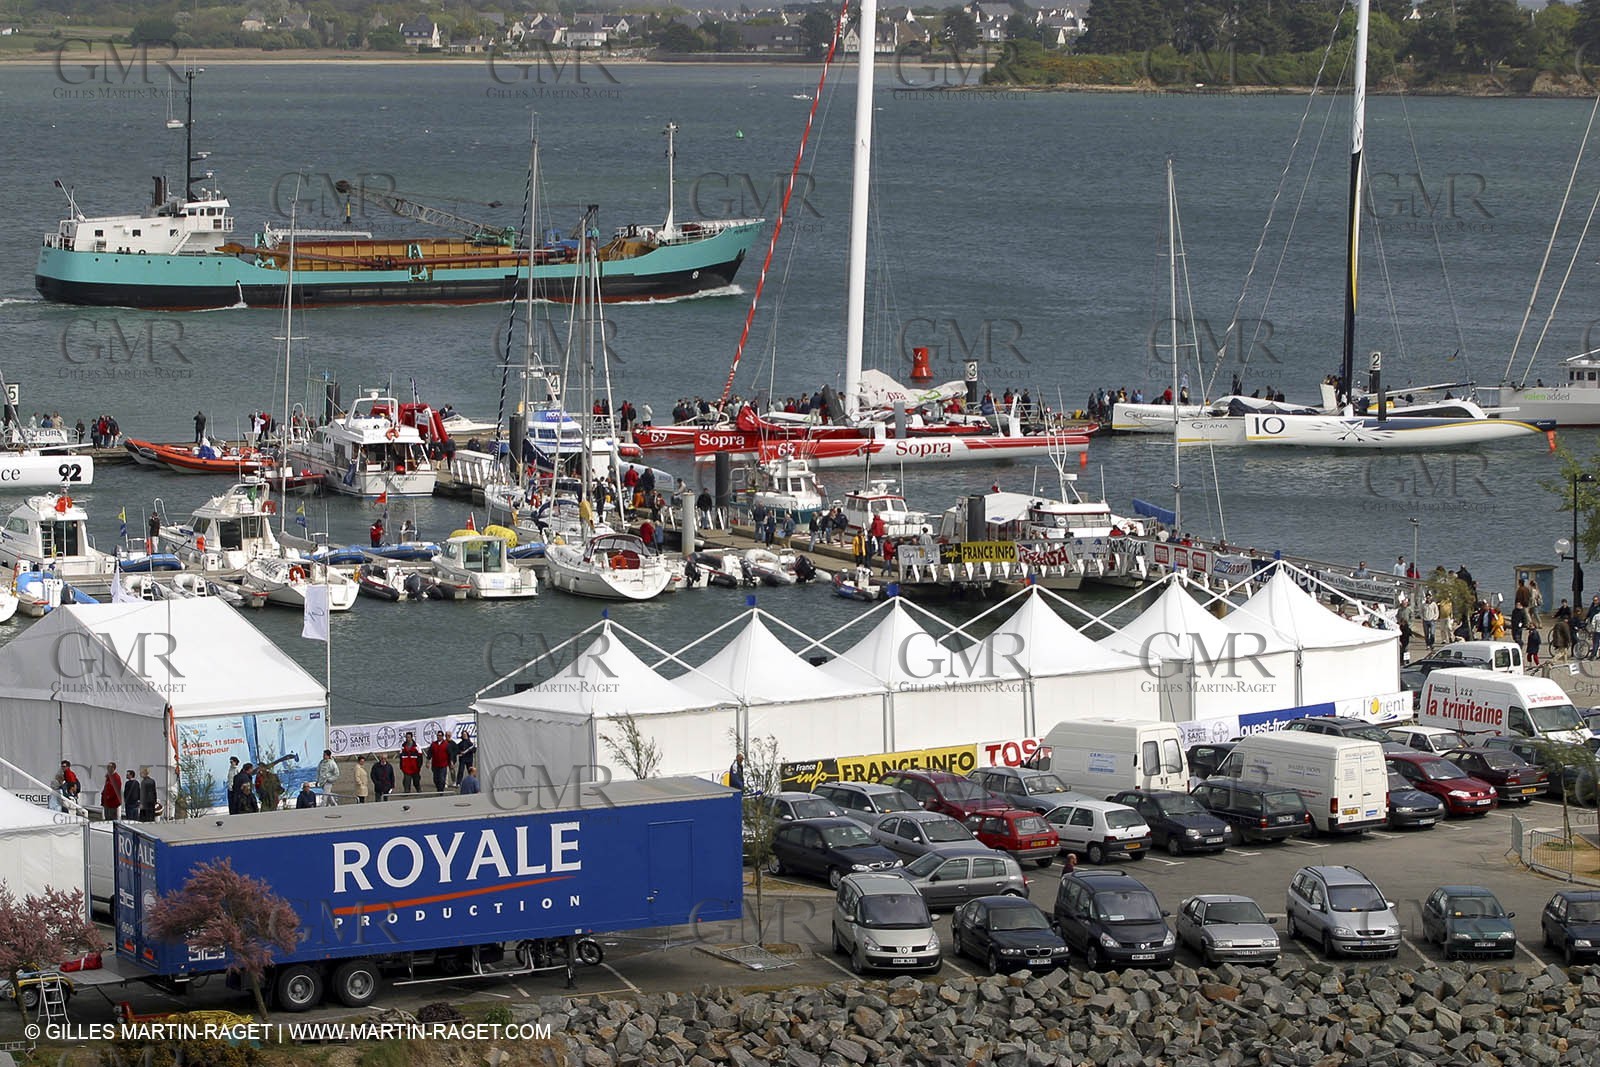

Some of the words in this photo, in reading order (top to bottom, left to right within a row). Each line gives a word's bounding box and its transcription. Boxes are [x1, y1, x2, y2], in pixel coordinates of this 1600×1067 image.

[1372, 353, 1381, 367] 2
[968, 363, 977, 377] 3
[8, 386, 16, 400] 5
[651, 431, 667, 443] 69
[699, 434, 745, 448] Sopra
[895, 440, 952, 458] Sopra
[58, 463, 82, 482] 92
[962, 545, 993, 559] FRANCE
[995, 545, 1016, 559] INFO
[1426, 684, 1438, 716] la
[1442, 697, 1503, 726] trinitaine
[796, 763, 816, 772] France
[925, 750, 976, 774] INFO
[16, 793, 49, 803] ERCIE
[333, 821, 582, 893] ROYALE
[334, 895, 581, 929] PRODUCTION
